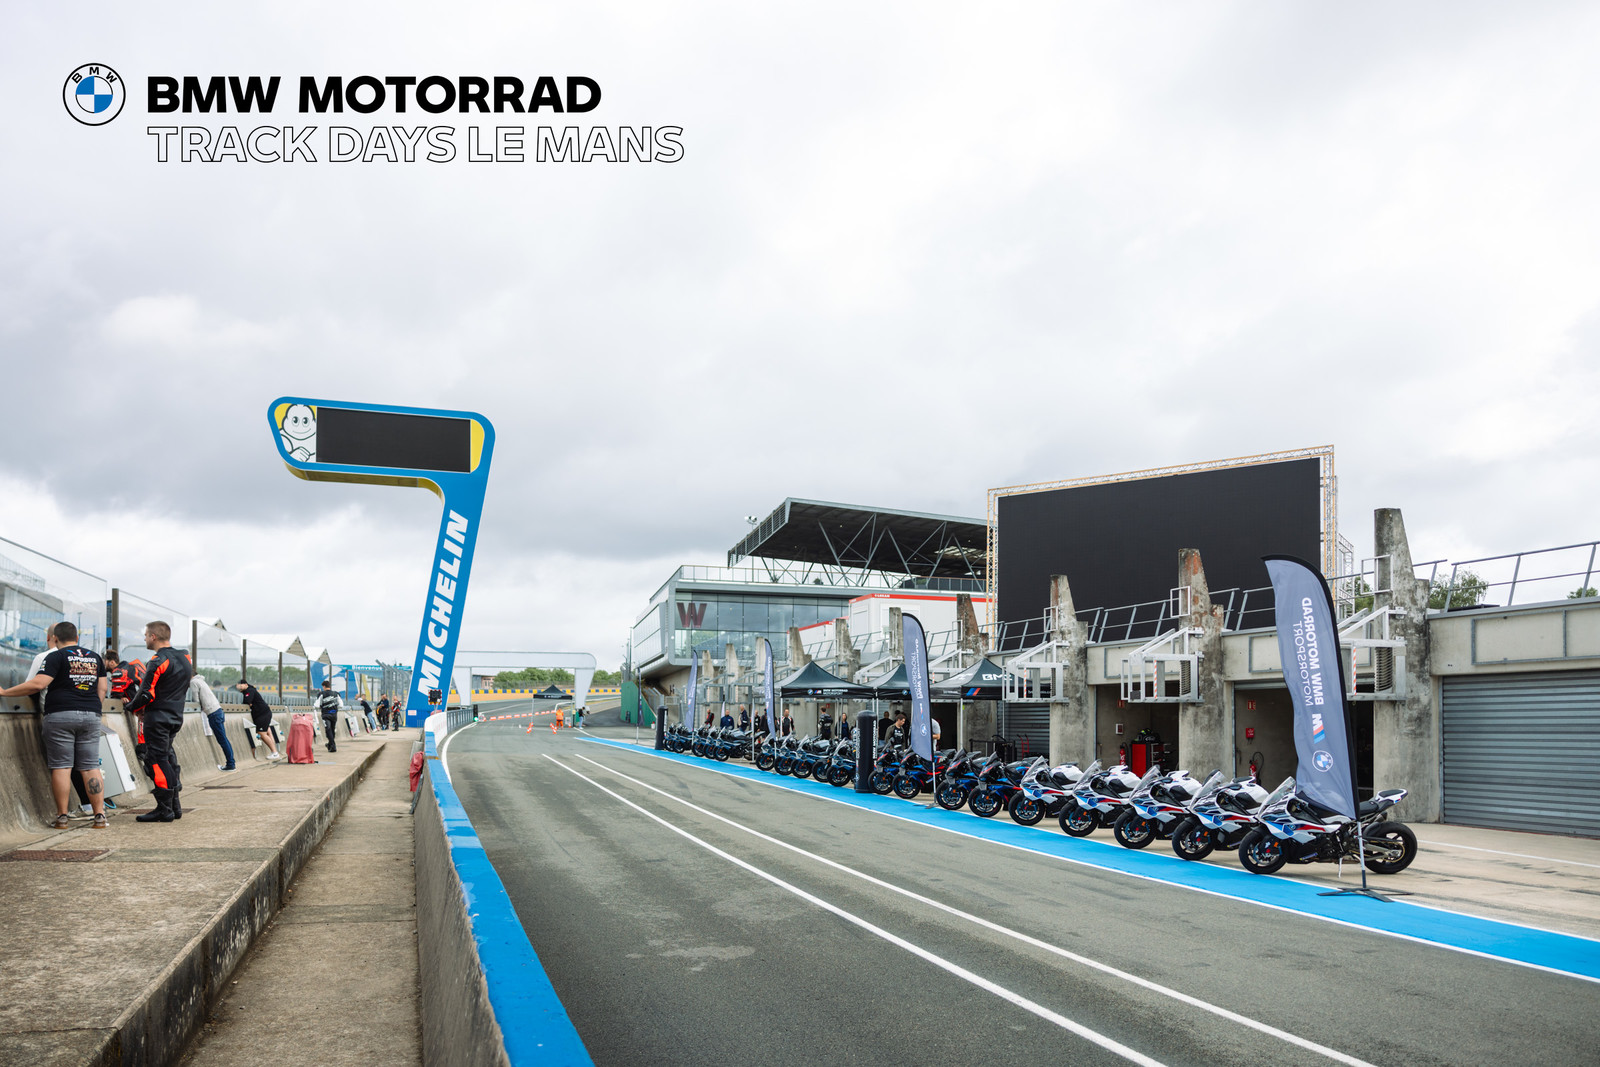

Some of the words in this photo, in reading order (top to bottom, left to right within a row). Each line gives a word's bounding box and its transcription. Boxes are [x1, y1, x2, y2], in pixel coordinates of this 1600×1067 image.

[418, 510, 468, 696] MICHELIN
[676, 602, 707, 628] W
[69, 661, 98, 669] WORLD
